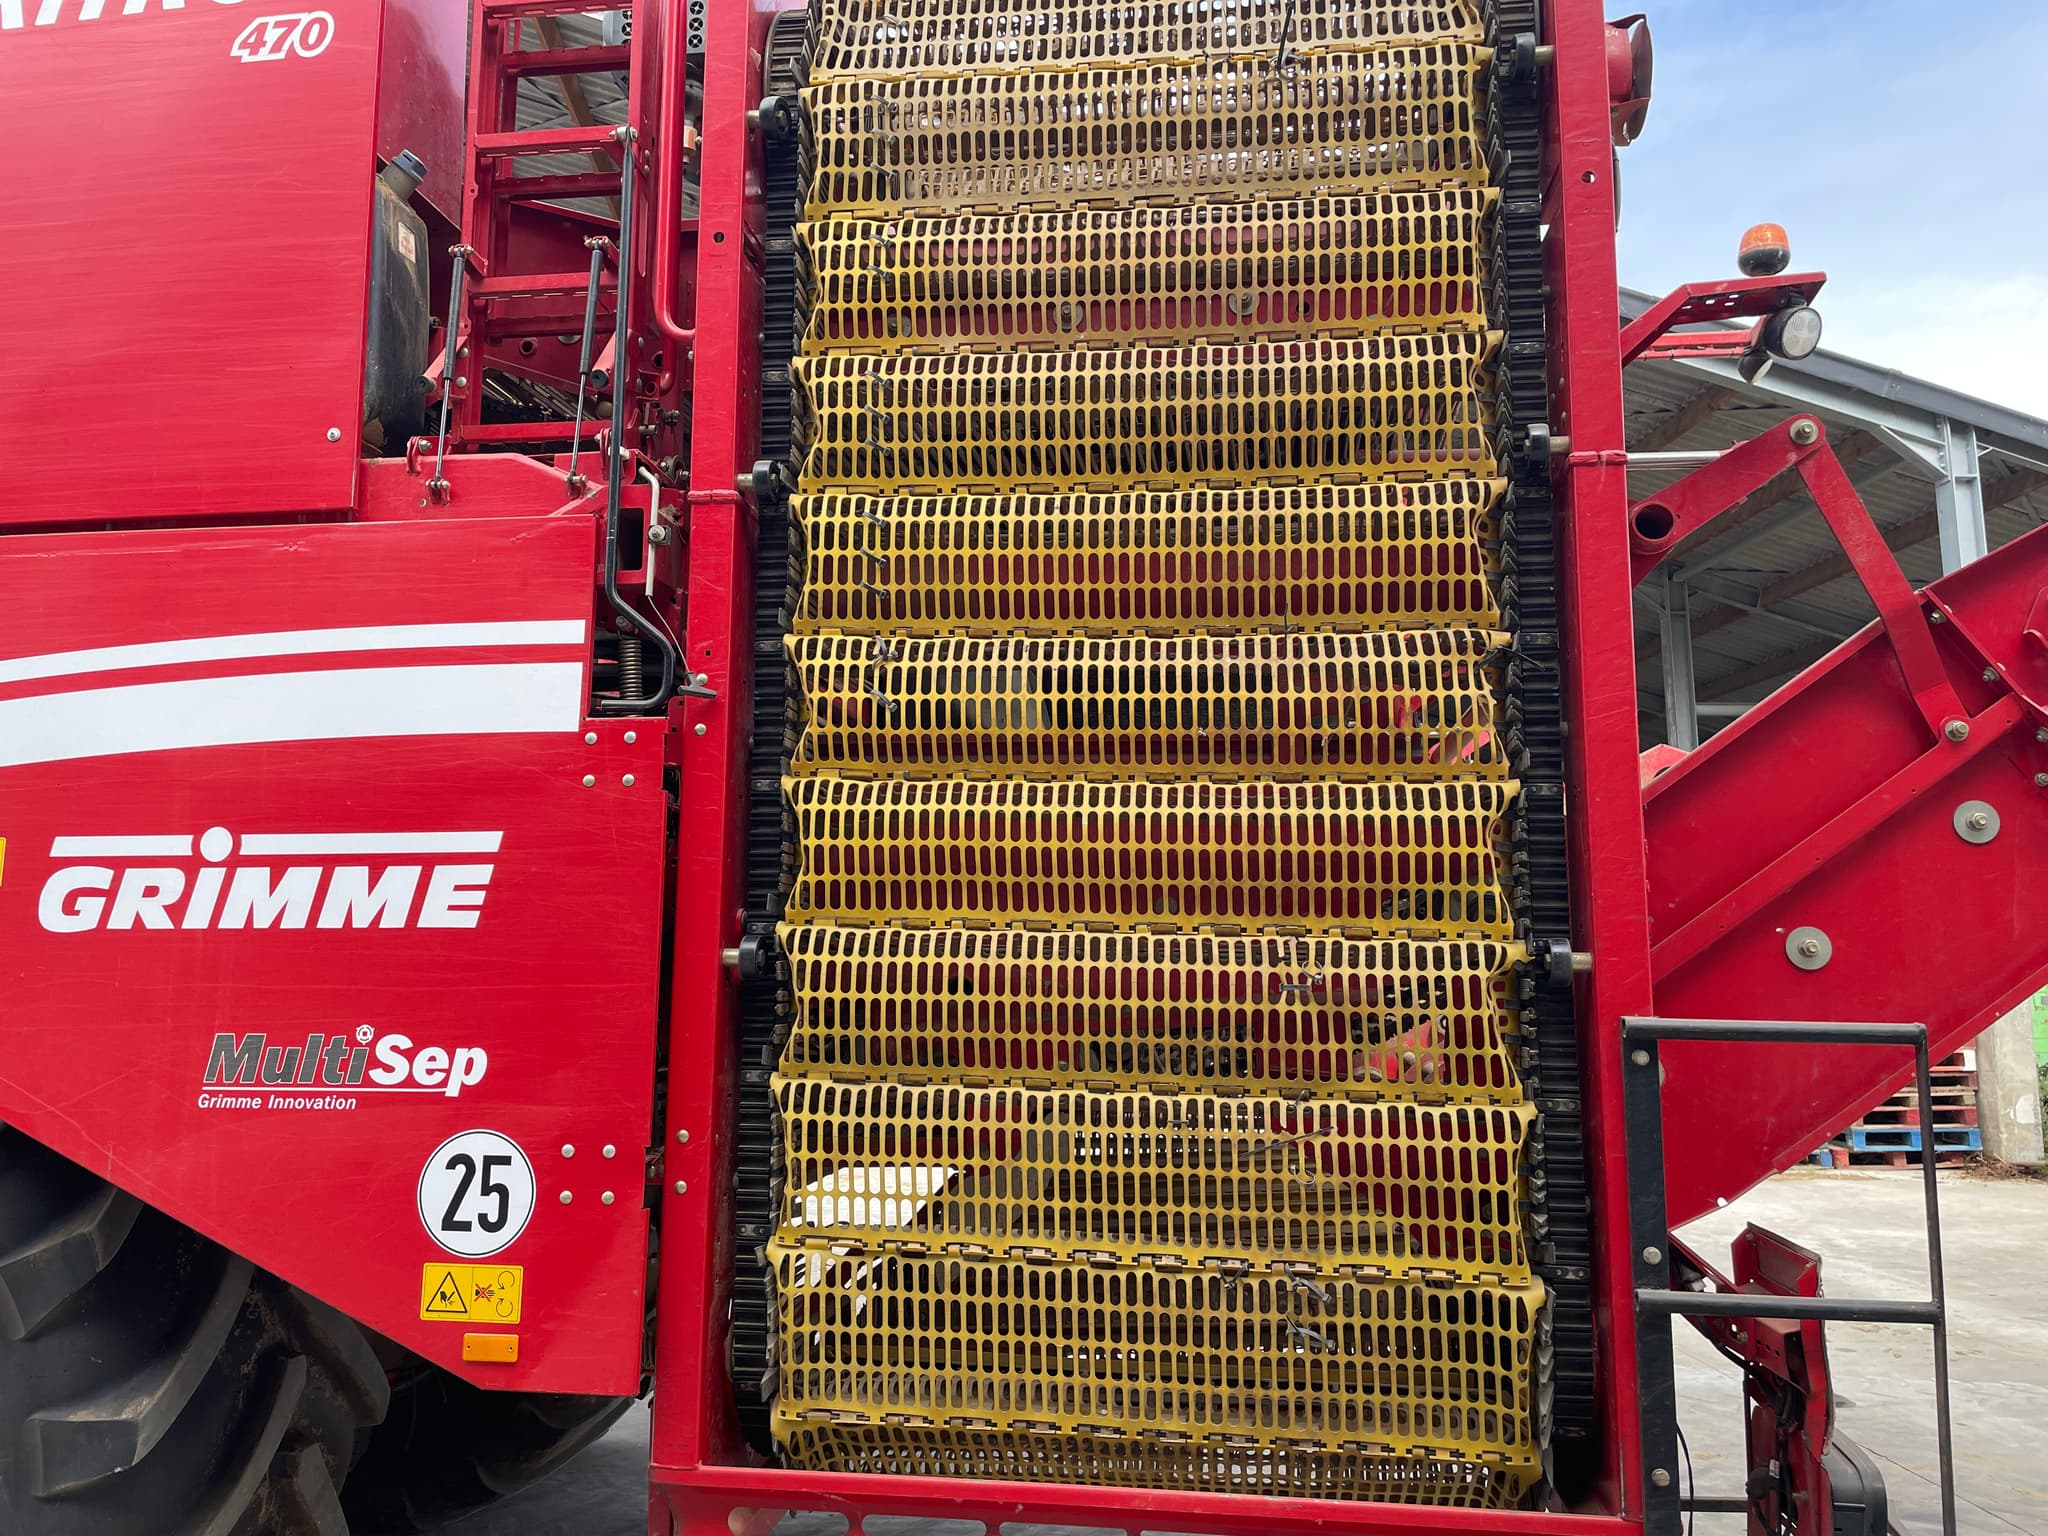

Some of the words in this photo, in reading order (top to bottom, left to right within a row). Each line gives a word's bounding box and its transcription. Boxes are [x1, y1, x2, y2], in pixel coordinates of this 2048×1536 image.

[230, 10, 335, 63] 470
[38, 827, 495, 933] GRIMME
[203, 1025, 488, 1098] MultiSep
[197, 1094, 262, 1110] Grimme
[268, 1094, 356, 1110] Innovation
[441, 1153, 512, 1233] 25
